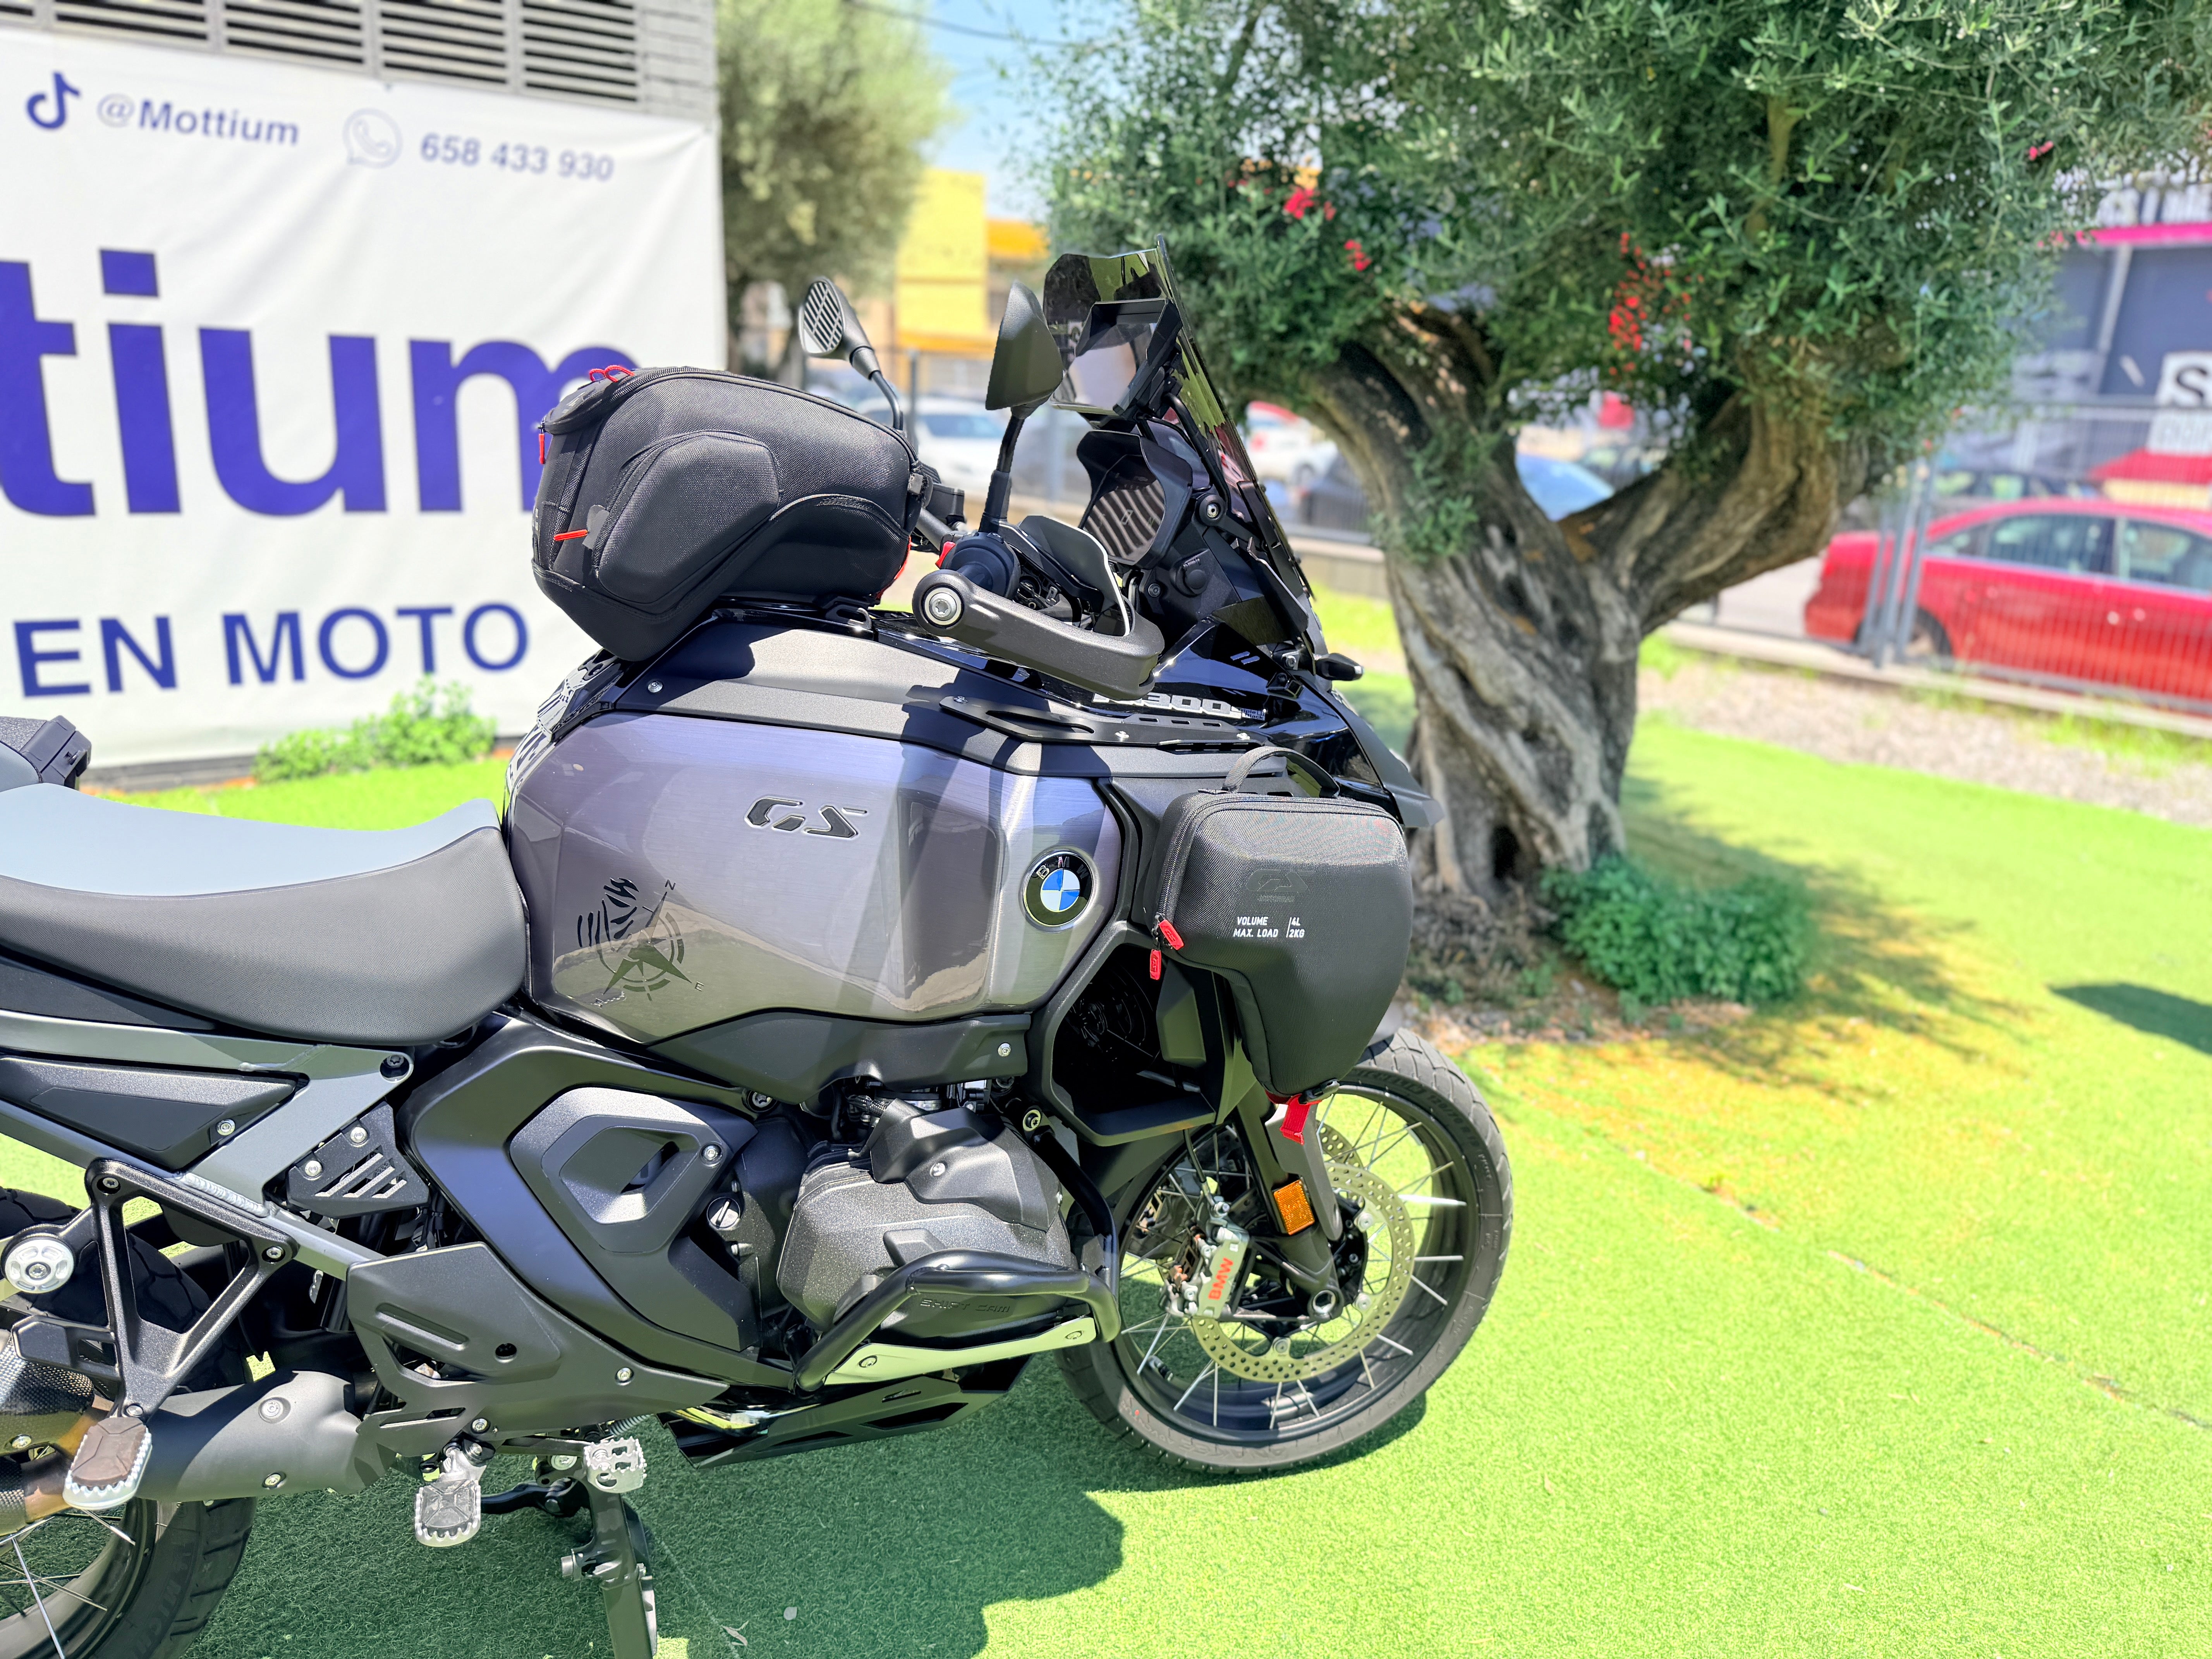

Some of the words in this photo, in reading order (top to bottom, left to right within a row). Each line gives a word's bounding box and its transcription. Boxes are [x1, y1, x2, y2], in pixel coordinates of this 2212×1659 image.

[96, 93, 300, 146] @Mottium
[421, 133, 480, 168] 658
[491, 140, 548, 174] 433
[559, 145, 615, 182] 930
[14, 616, 177, 697] EN
[222, 603, 529, 685] MOTO
[1093, 692, 1242, 719] 300
[745, 796, 867, 840] GS
[1036, 856, 1089, 880] BMW
[1233, 928, 1254, 937] MAX.
[1257, 929, 1279, 937] LOAD
[1288, 929, 1305, 938] 2KG
[1237, 916, 1269, 925] VOLUME
[1291, 917, 1301, 926] 4L
[1207, 1257, 1234, 1300] BMW
[920, 1299, 970, 1310] SHIFT
